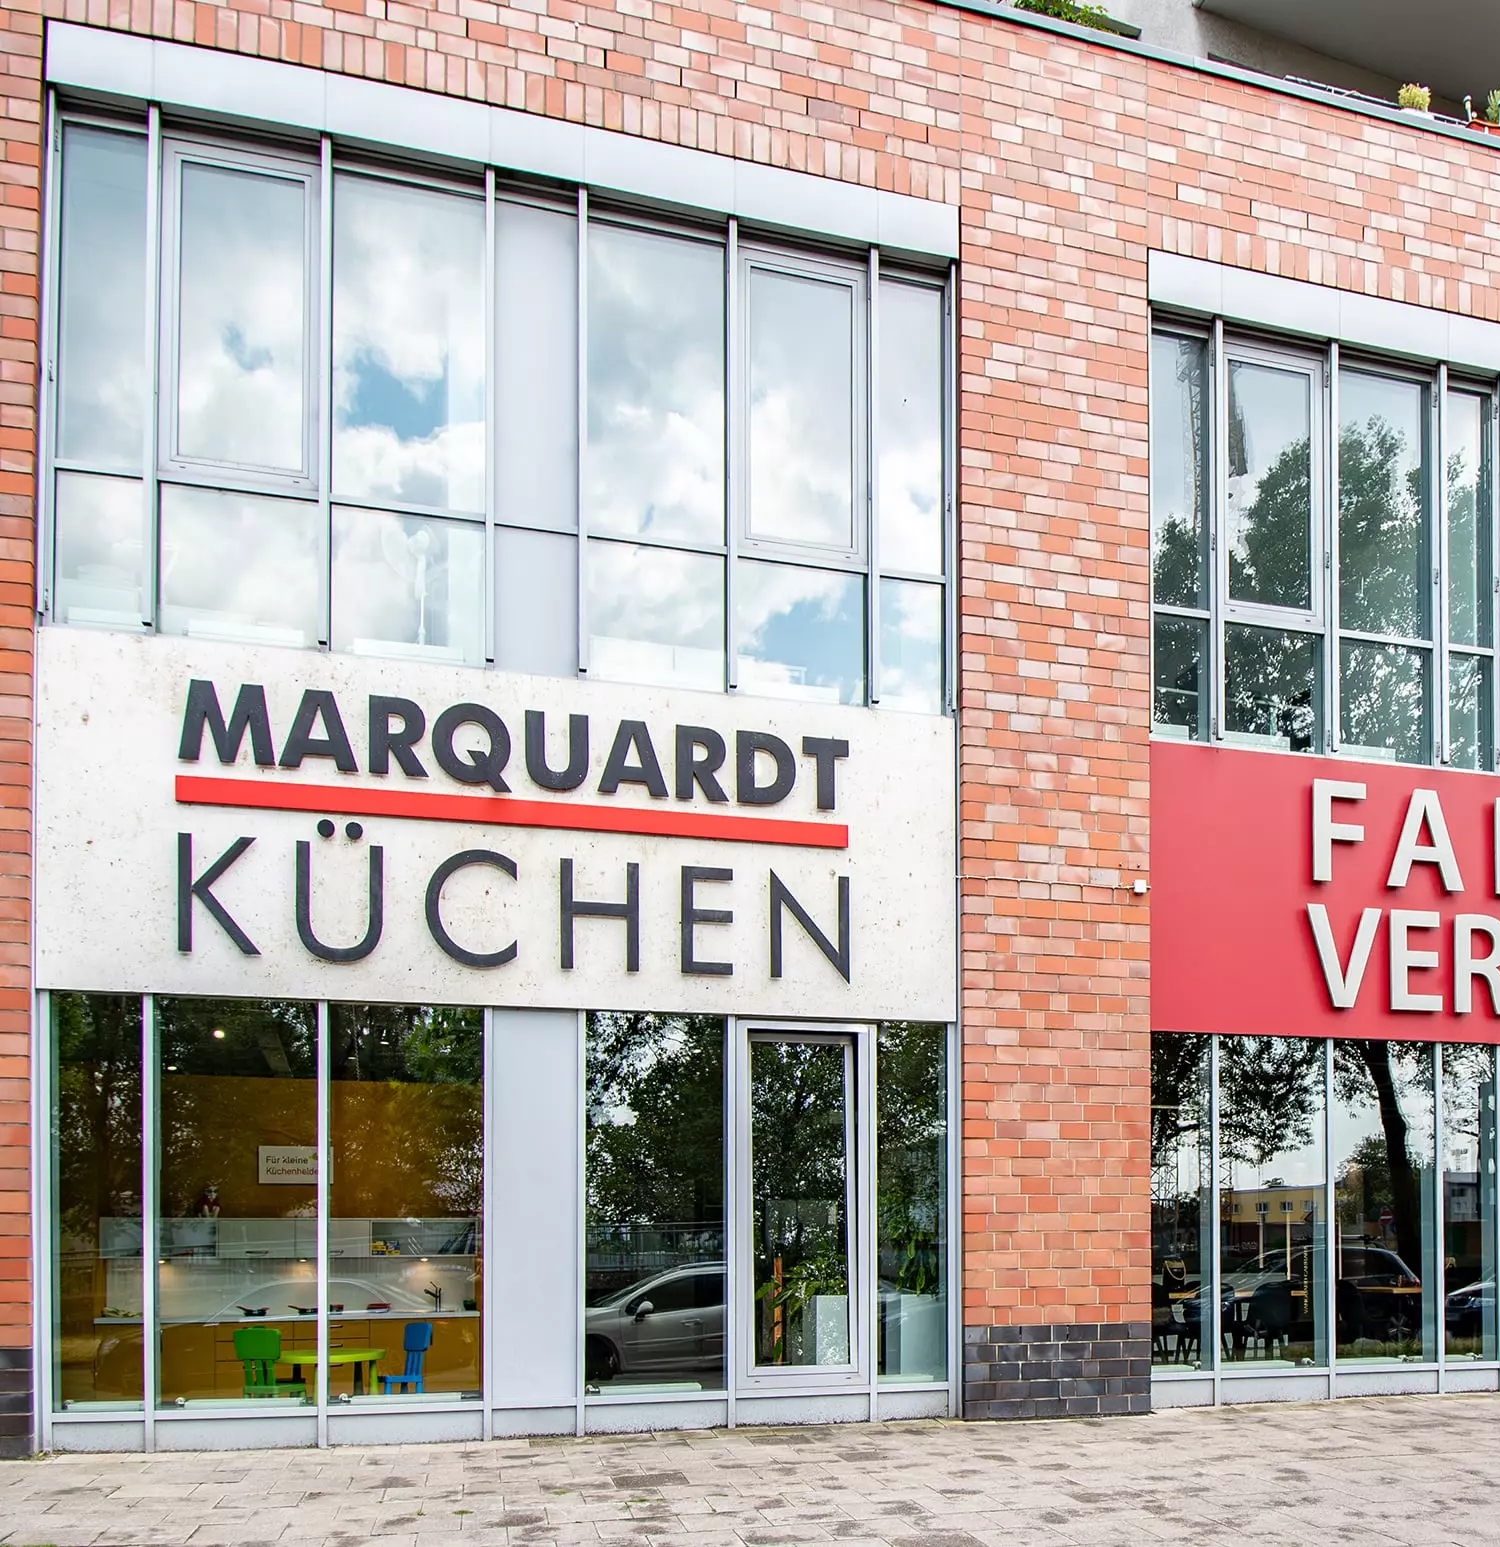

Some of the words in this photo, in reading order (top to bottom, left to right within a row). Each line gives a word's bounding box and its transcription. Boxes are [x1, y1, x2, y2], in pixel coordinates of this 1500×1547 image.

[177, 678, 850, 810] MARQUARDT
[177, 818, 852, 984] KÜCHEN
[266, 1155, 280, 1164] Für
[282, 1156, 308, 1164] kleine
